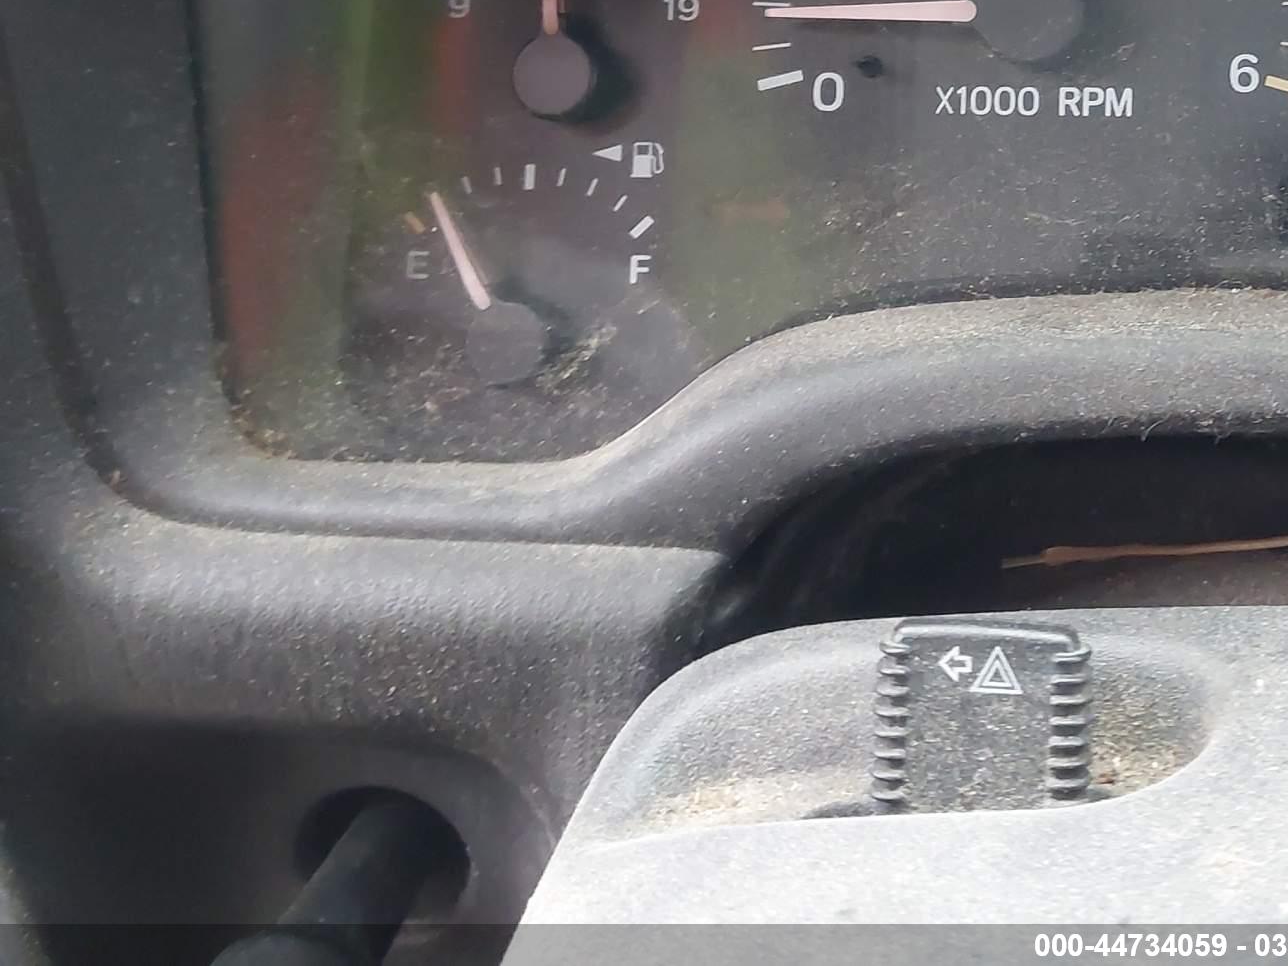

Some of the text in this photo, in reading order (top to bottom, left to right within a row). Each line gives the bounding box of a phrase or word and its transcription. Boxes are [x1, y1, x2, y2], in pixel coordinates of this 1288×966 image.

[1229, 54, 1260, 93] 6
[812, 72, 845, 112] 0
[935, 86, 1133, 117] X1000 RPM
[406, 251, 430, 279] E
[630, 255, 651, 284] F
